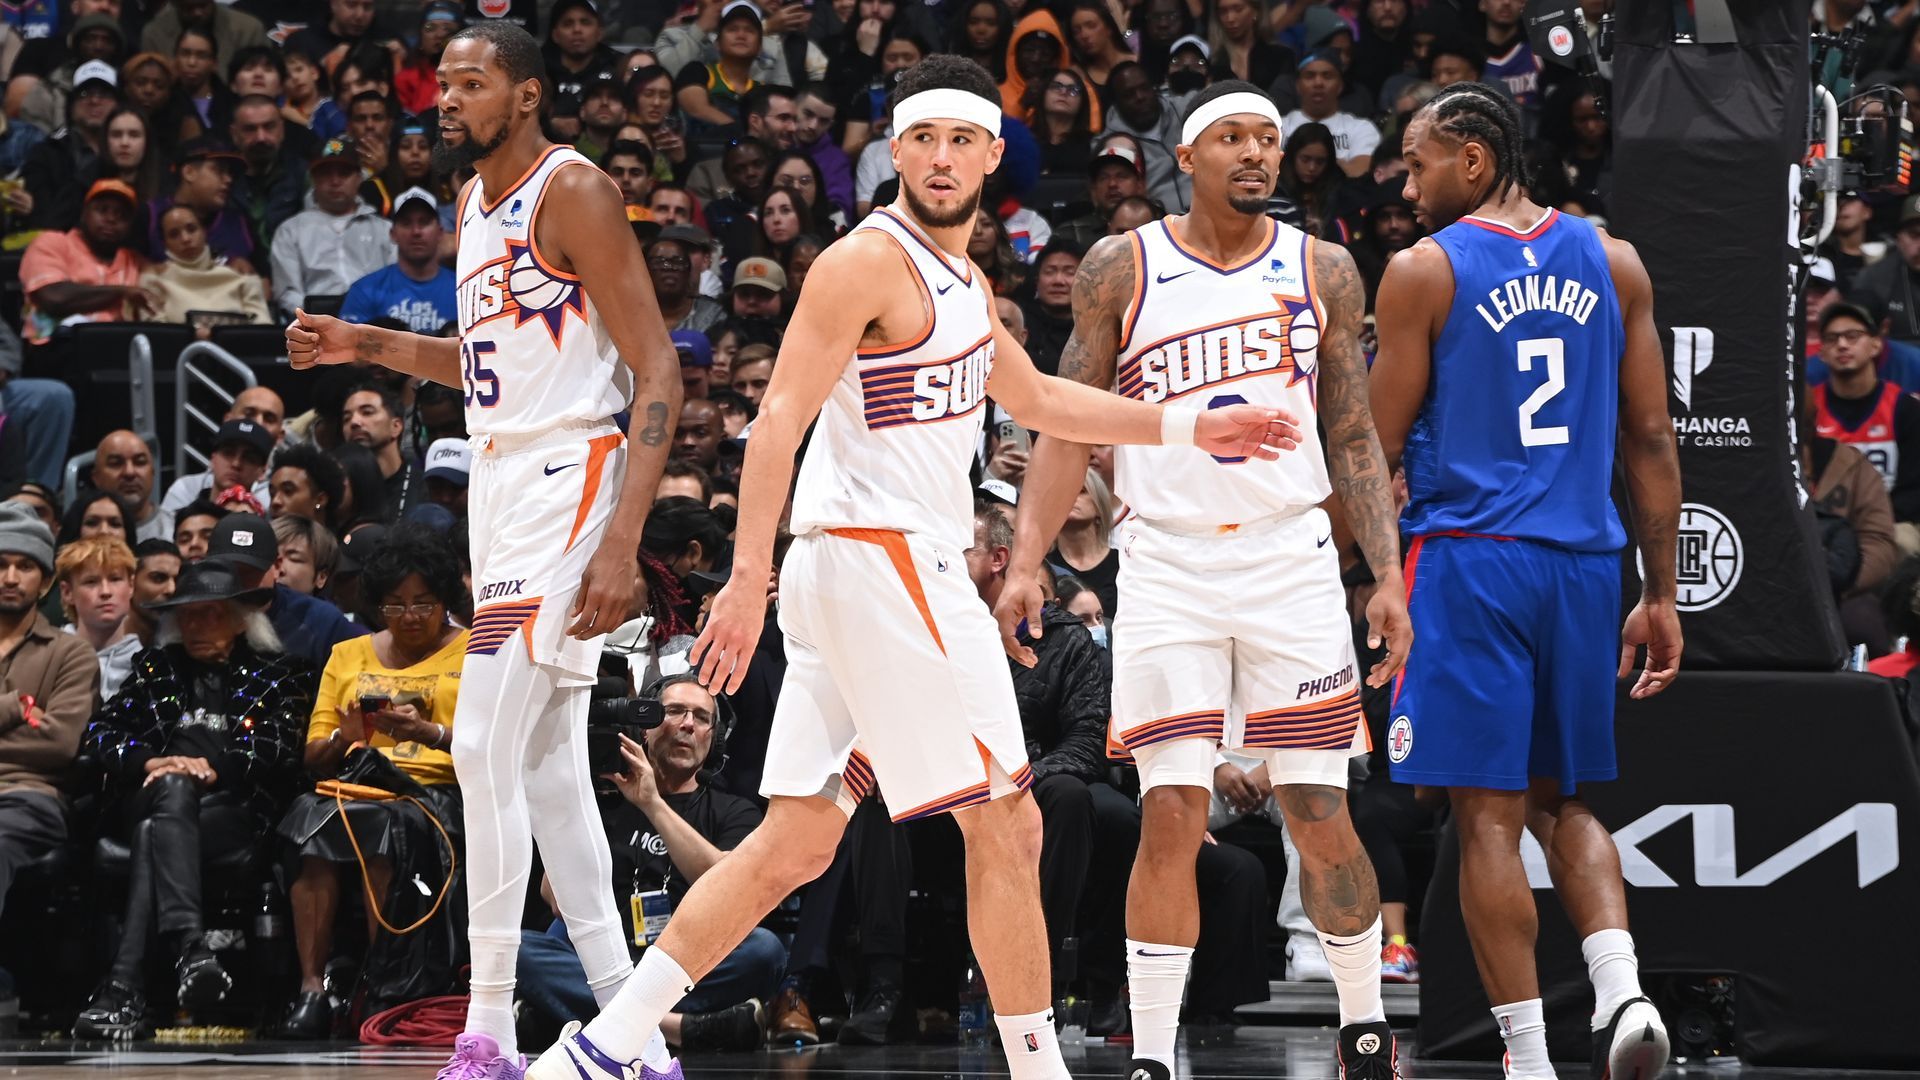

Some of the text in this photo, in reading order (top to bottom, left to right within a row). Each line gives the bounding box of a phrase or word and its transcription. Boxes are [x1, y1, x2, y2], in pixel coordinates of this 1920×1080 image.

[501, 219, 524, 229] PayPal
[1262, 275, 1297, 284] PayPal
[1475, 274, 1599, 333] LEONARD
[462, 340, 500, 408] 35
[1140, 318, 1283, 403] SUNS
[1517, 337, 1569, 447] 2
[1694, 436, 1753, 448] CASINO
[1295, 663, 1354, 700] PHOENIX
